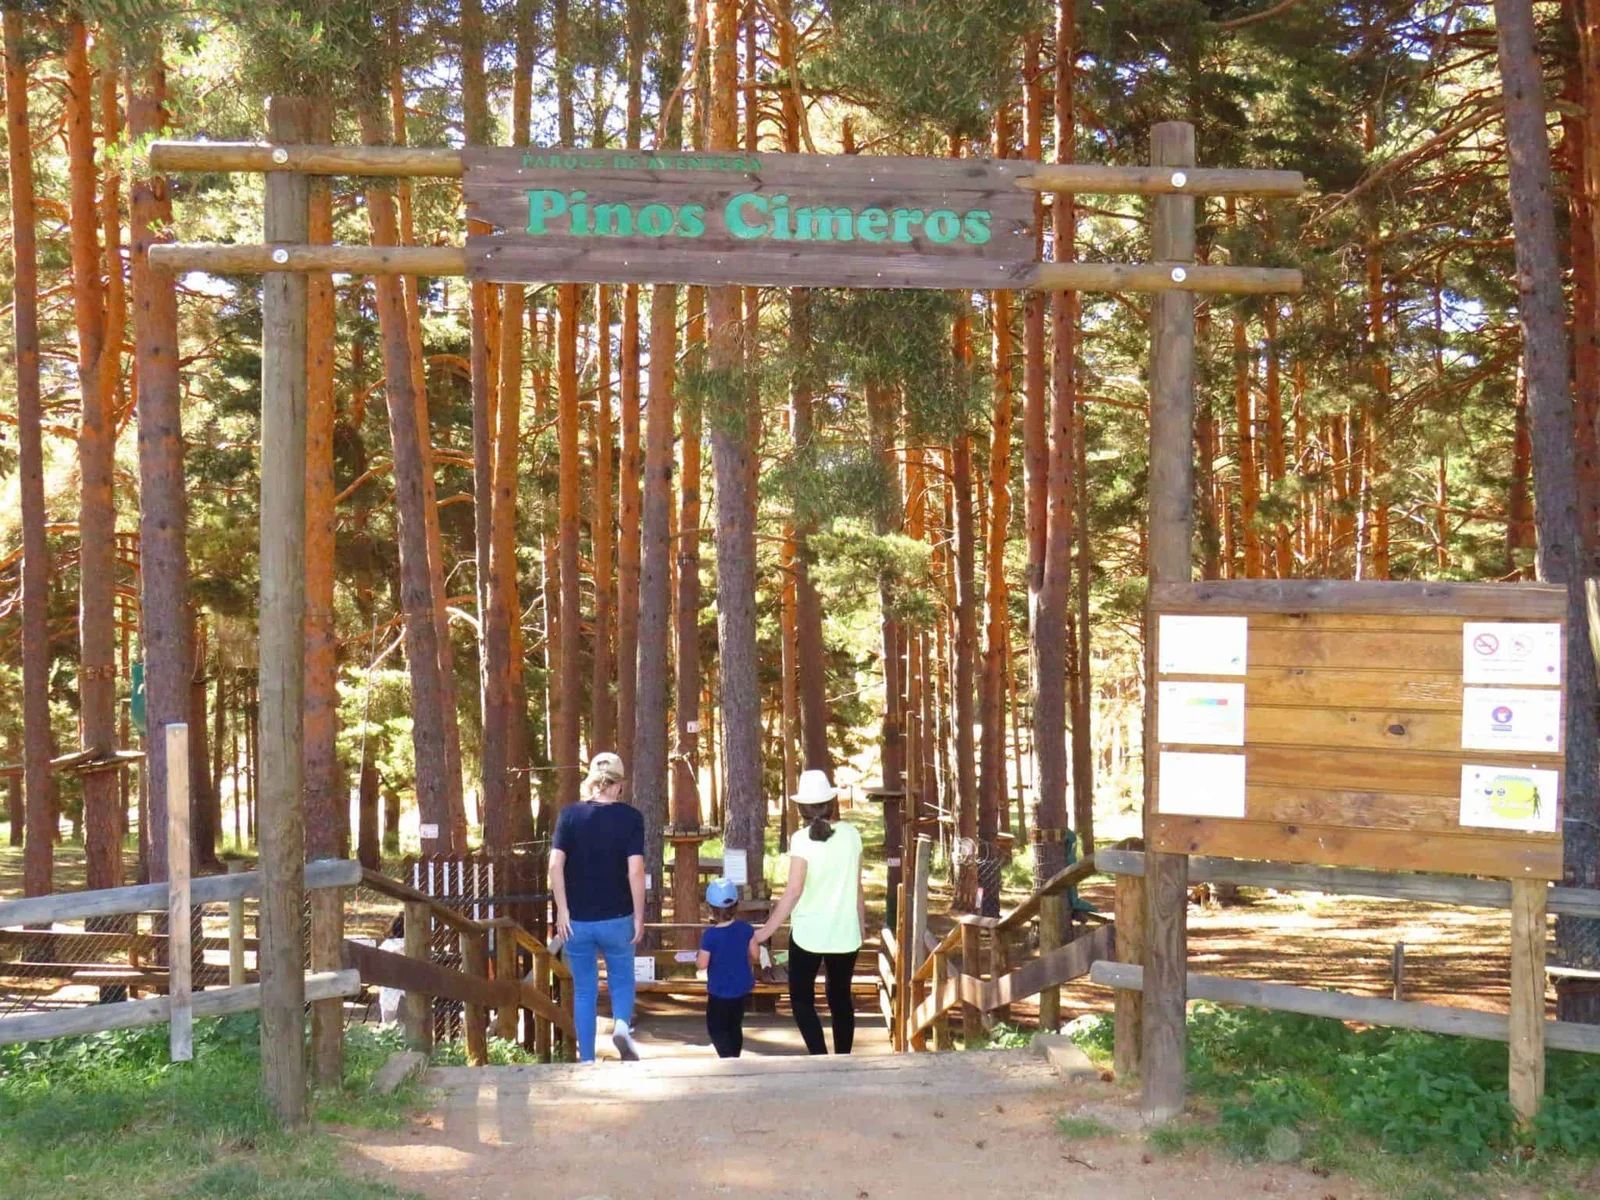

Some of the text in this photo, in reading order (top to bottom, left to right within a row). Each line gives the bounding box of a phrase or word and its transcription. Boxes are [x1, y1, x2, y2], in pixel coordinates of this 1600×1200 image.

[522, 154, 762, 171] PARQUE DE AVENTURA
[525, 188, 992, 244] Pinos Cimeros
